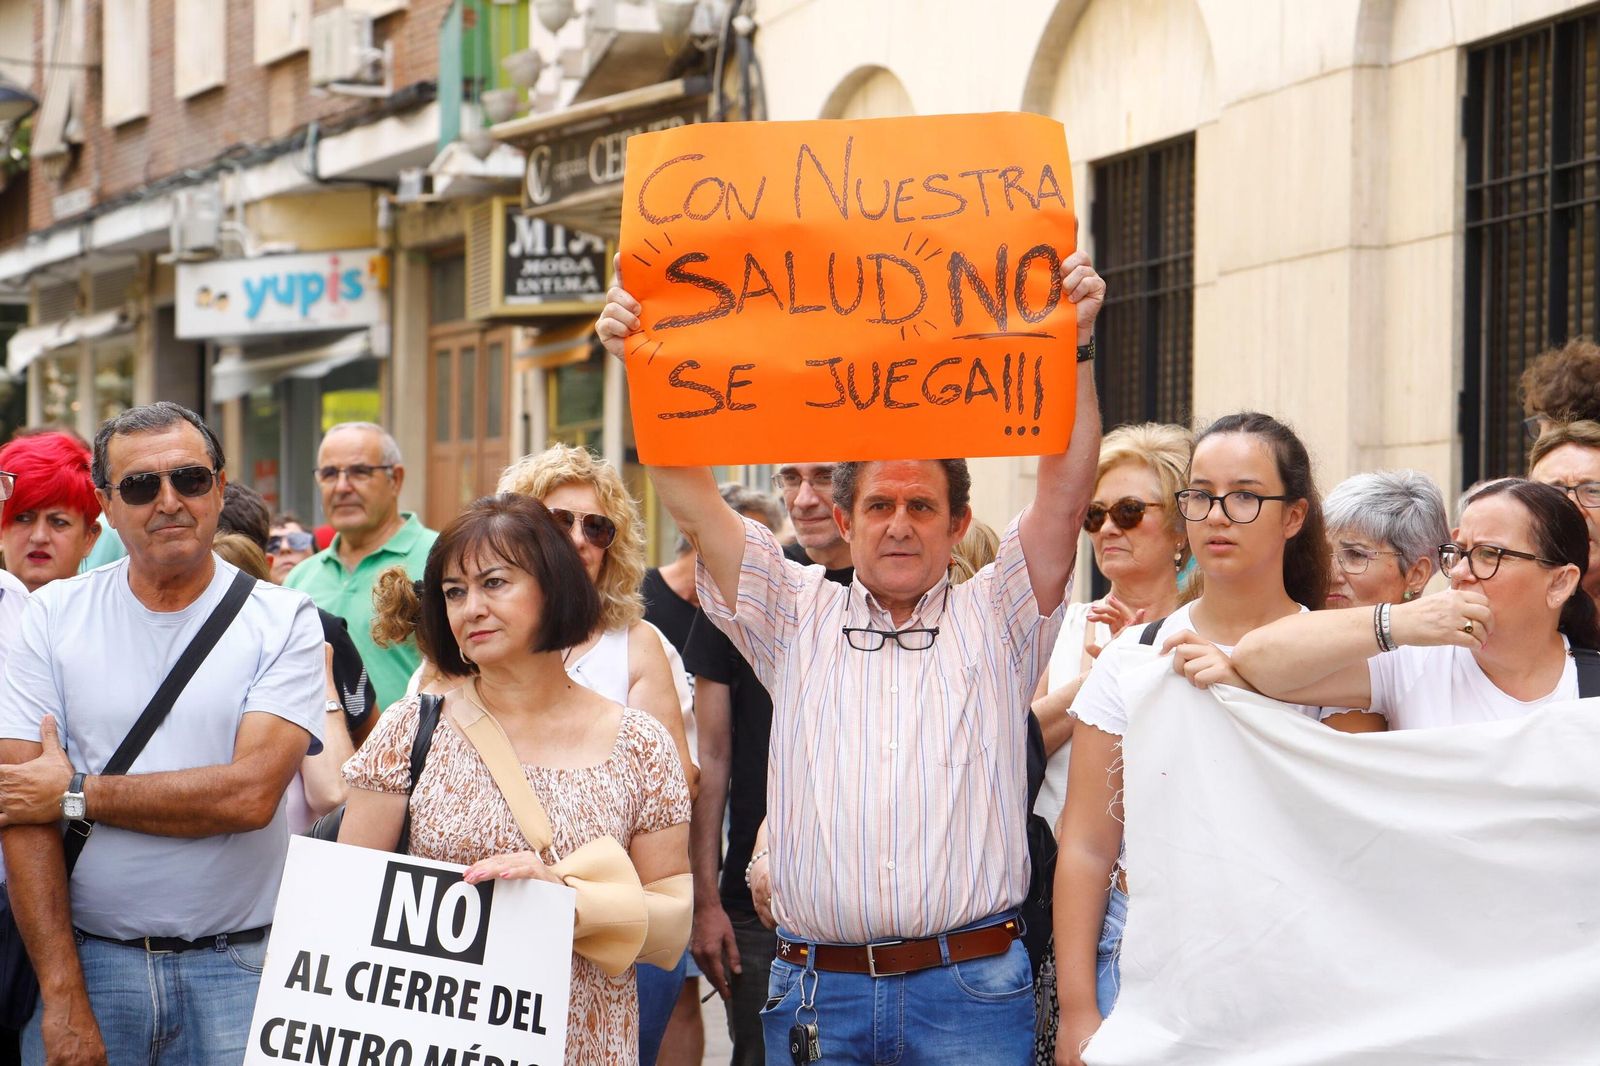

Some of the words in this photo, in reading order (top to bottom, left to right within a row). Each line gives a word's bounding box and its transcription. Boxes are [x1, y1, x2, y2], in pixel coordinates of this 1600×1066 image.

[638, 153, 766, 225] CON
[794, 136, 1067, 223] NUESTRA
[242, 255, 365, 319] yupis
[520, 257, 595, 276] MODA
[652, 250, 927, 331] SALUD
[946, 243, 1063, 334] NO
[657, 359, 757, 420] SE
[805, 352, 1045, 437] JUEGA!!!
[383, 870, 481, 953] NO
[284, 950, 333, 996] AL
[345, 961, 481, 1021] CIERRE
[488, 985, 547, 1036] DEL
[259, 1017, 413, 1066] CENTRO
